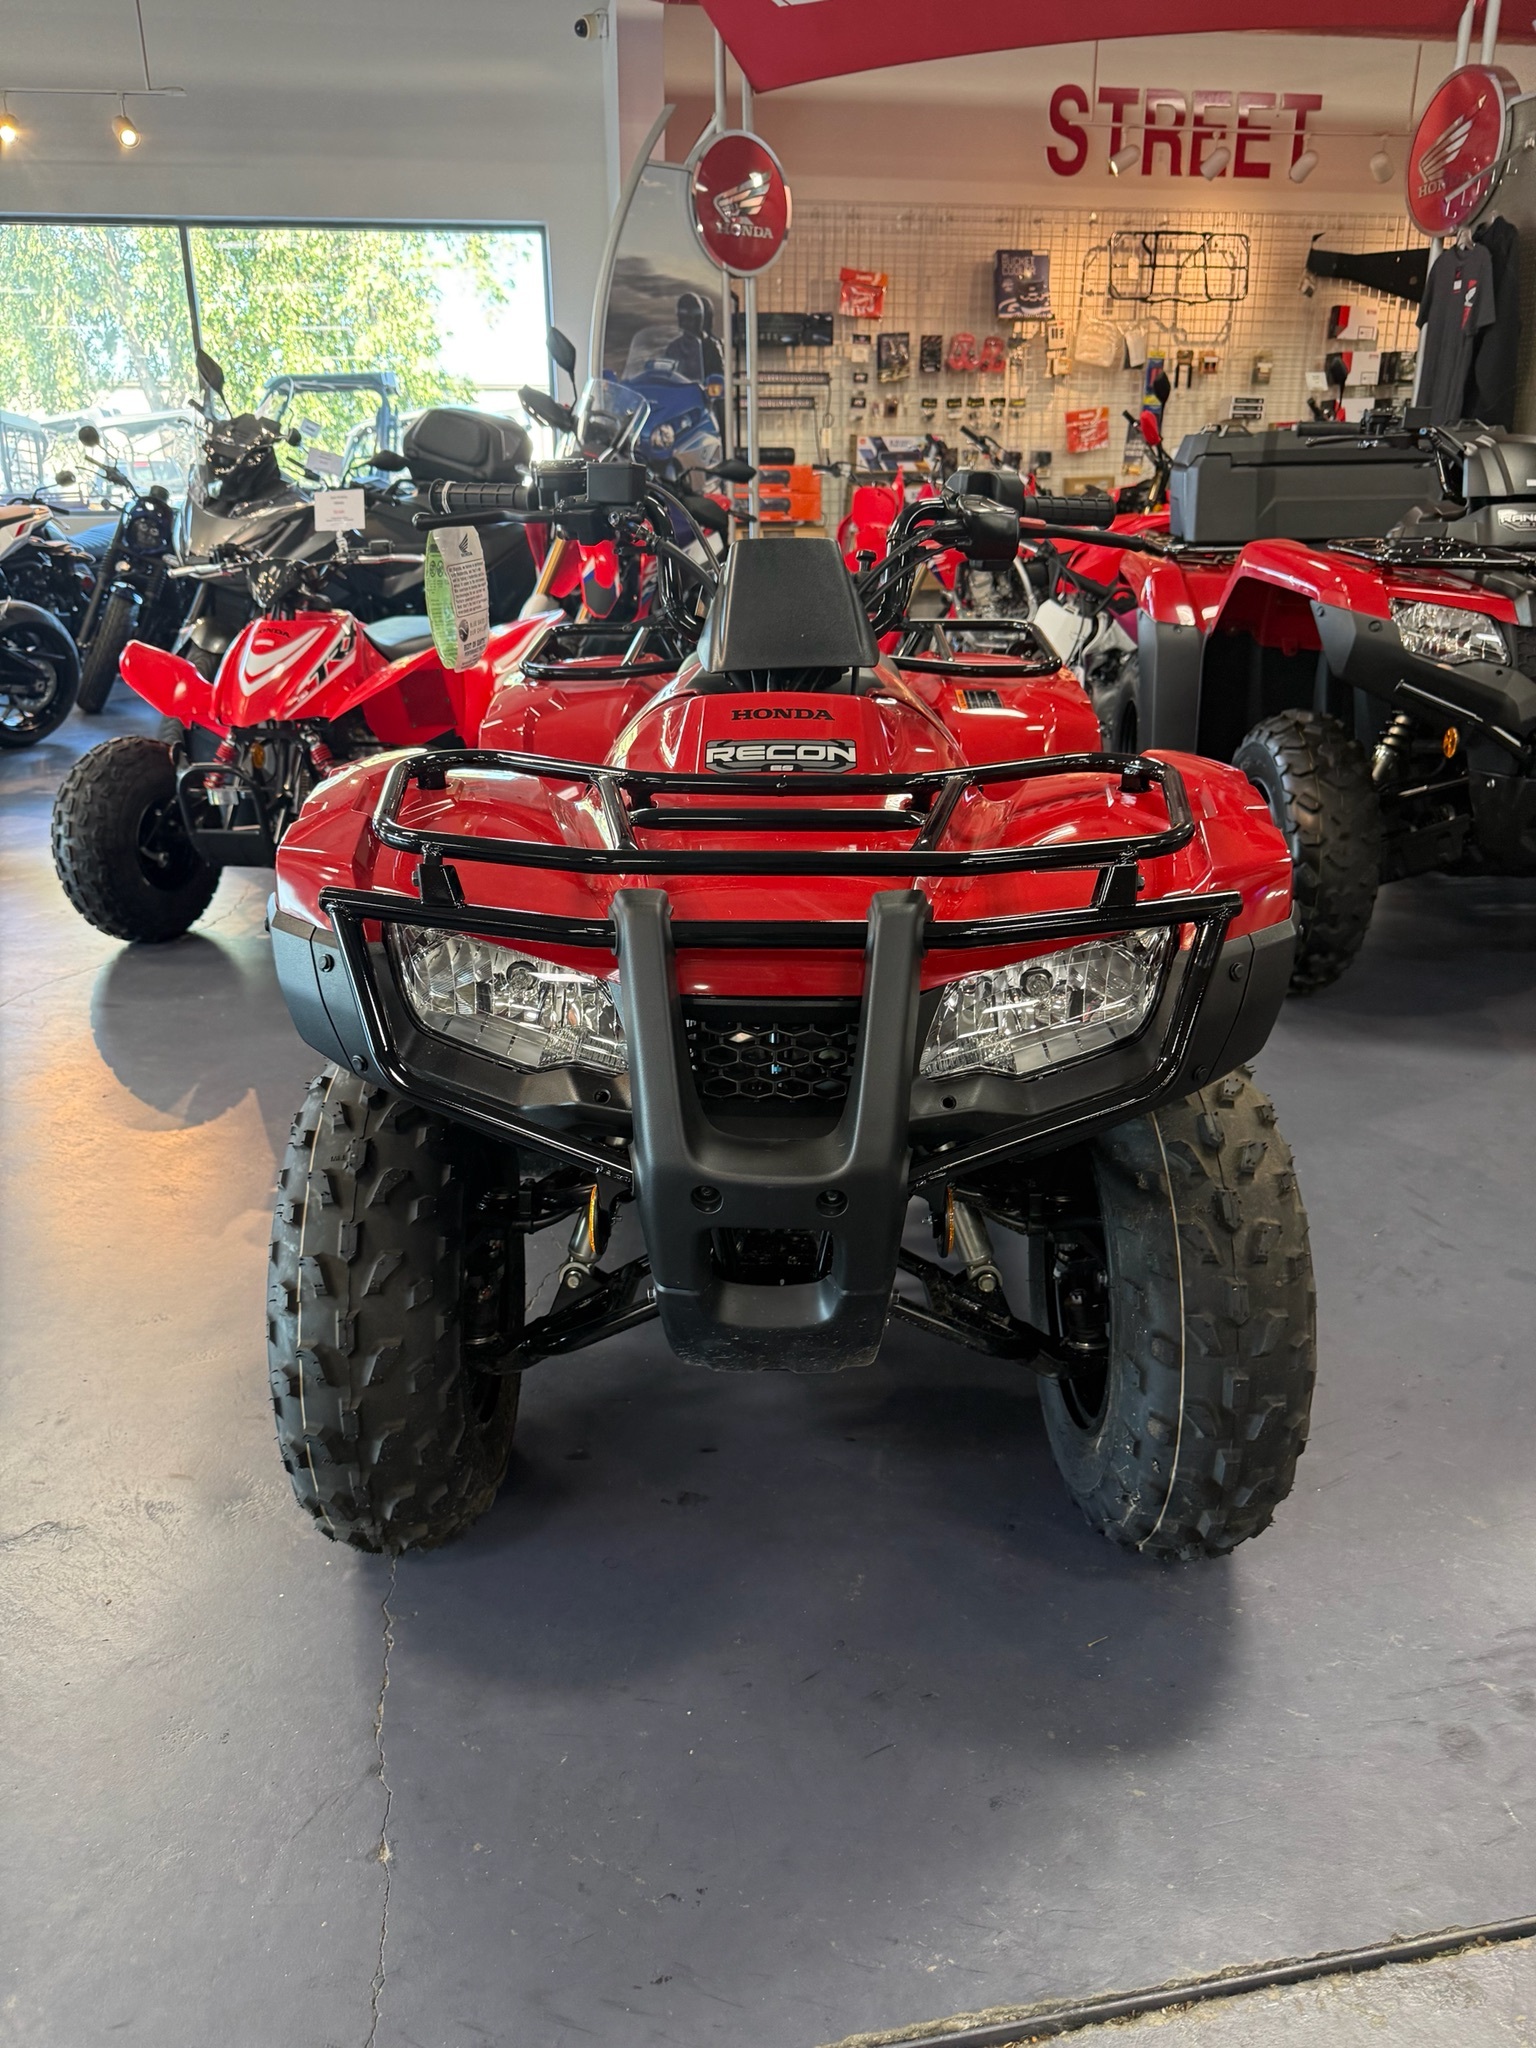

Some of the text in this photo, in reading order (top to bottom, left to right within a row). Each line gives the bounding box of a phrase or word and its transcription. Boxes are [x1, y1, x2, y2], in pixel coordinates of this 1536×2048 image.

[1047, 84, 1323, 177] STREET
[716, 221, 774, 239] HONDA
[731, 708, 835, 721] HONDA
[706, 745, 856, 763] RECON
